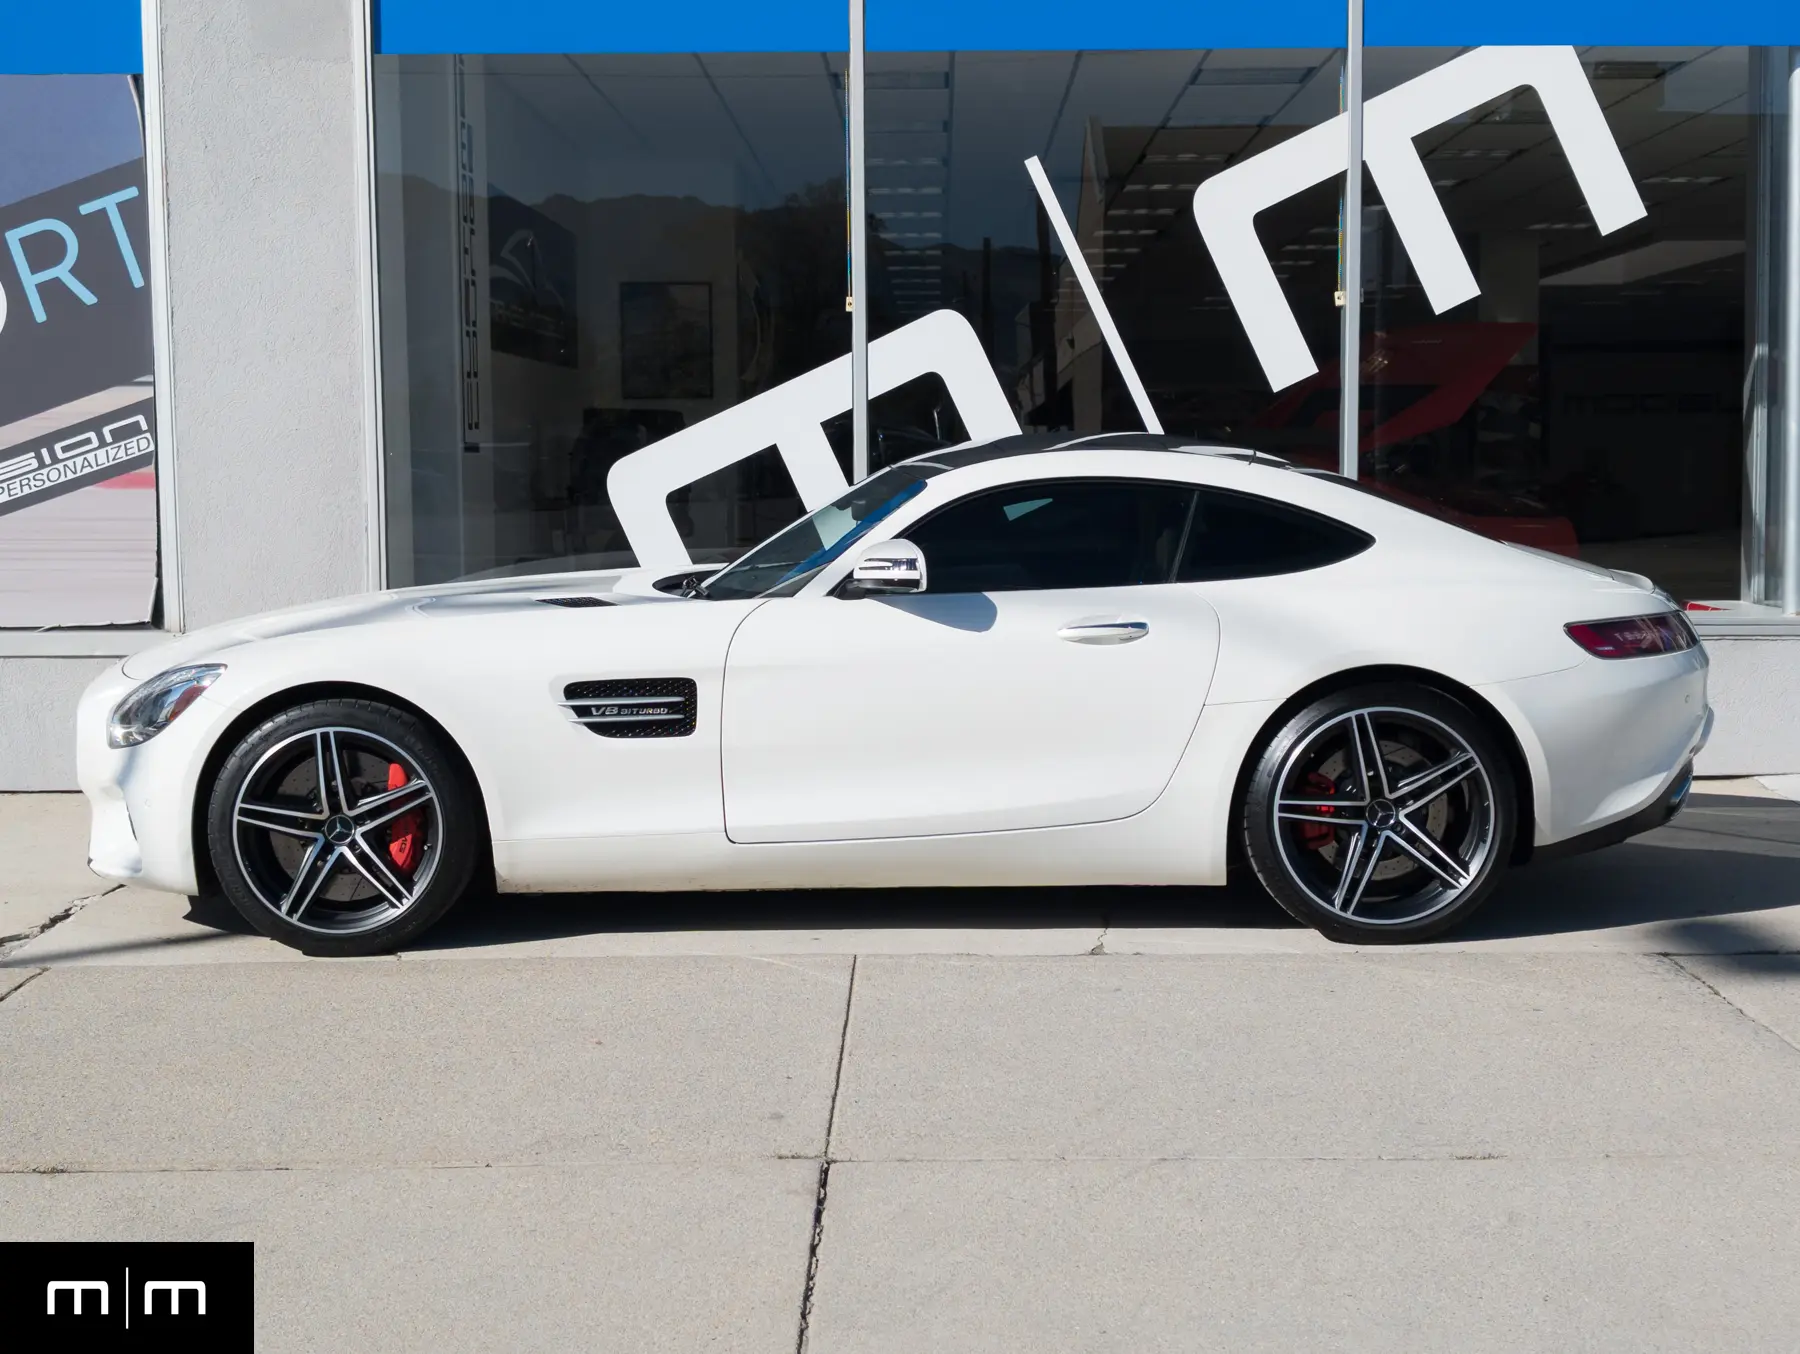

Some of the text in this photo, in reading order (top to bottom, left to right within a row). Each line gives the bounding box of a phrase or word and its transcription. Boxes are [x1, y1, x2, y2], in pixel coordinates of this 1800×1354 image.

[0, 186, 145, 334] RT
[590, 706, 669, 716] V8 BITURBO
